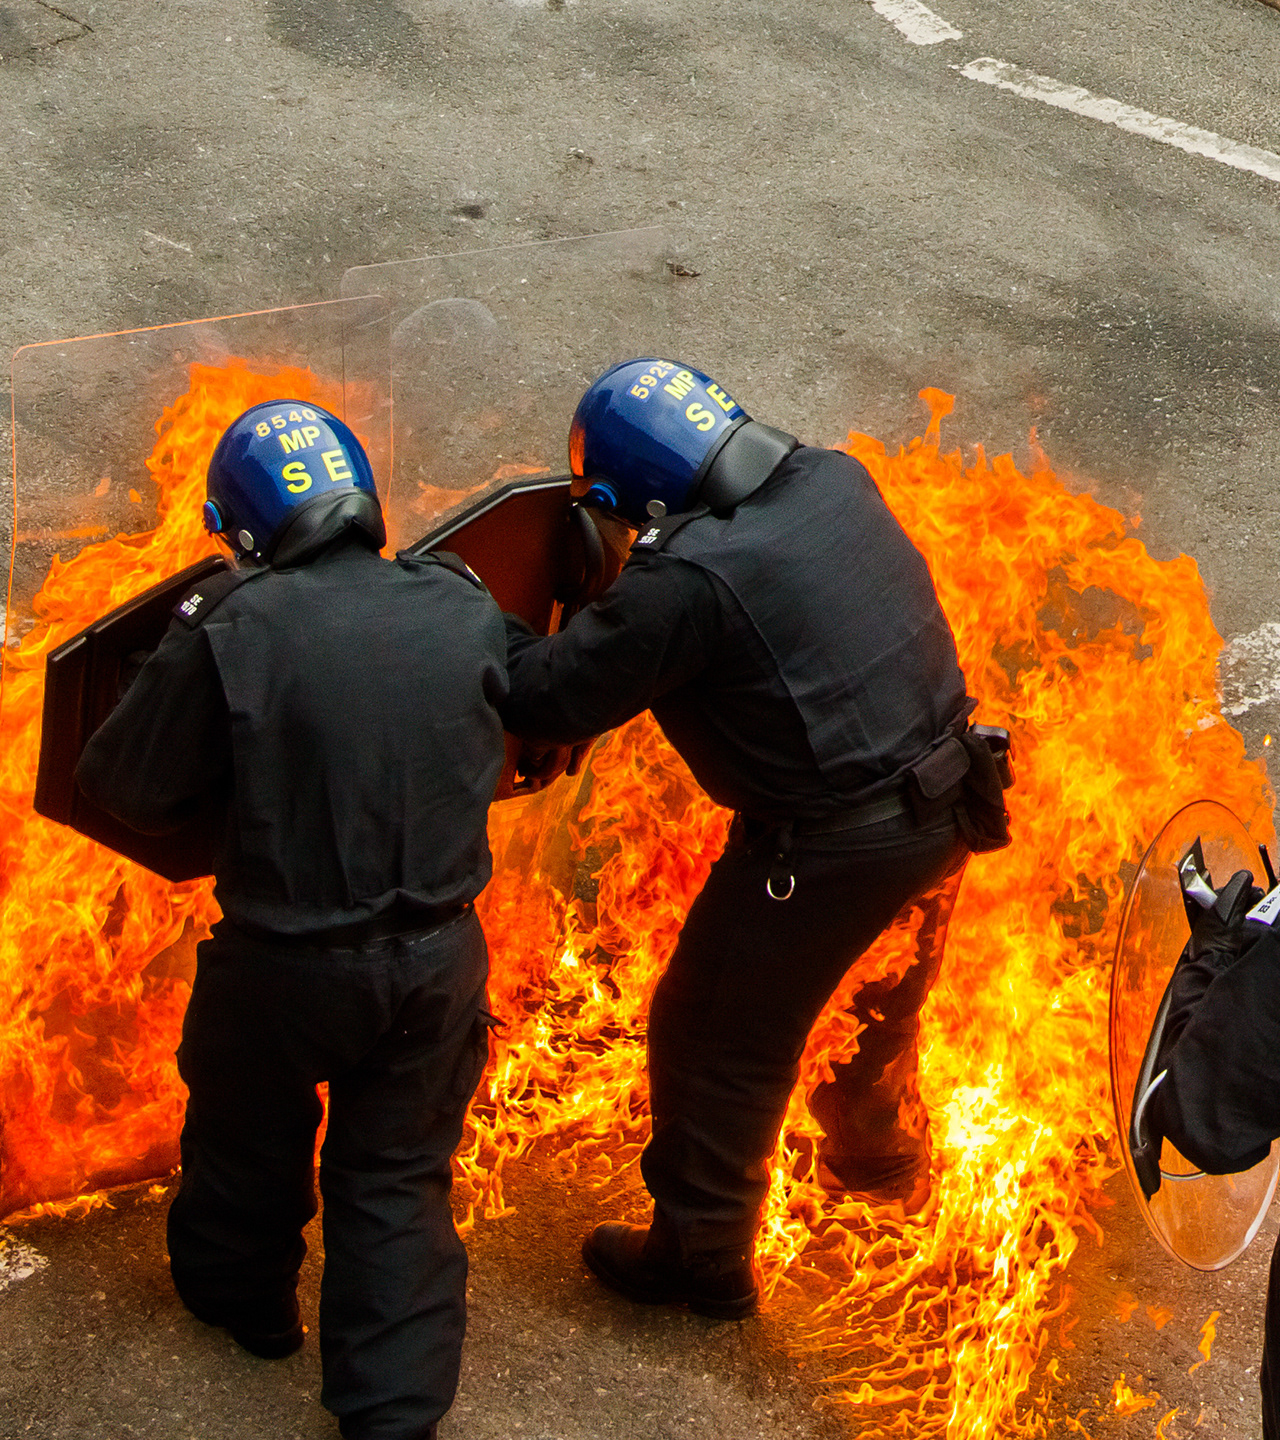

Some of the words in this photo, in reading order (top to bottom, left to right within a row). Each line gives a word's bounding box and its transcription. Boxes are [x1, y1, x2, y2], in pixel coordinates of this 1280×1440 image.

[630, 360, 675, 399] 5925
[663, 370, 696, 401] MP
[255, 409, 317, 437] 8540
[278, 425, 320, 454] MP
